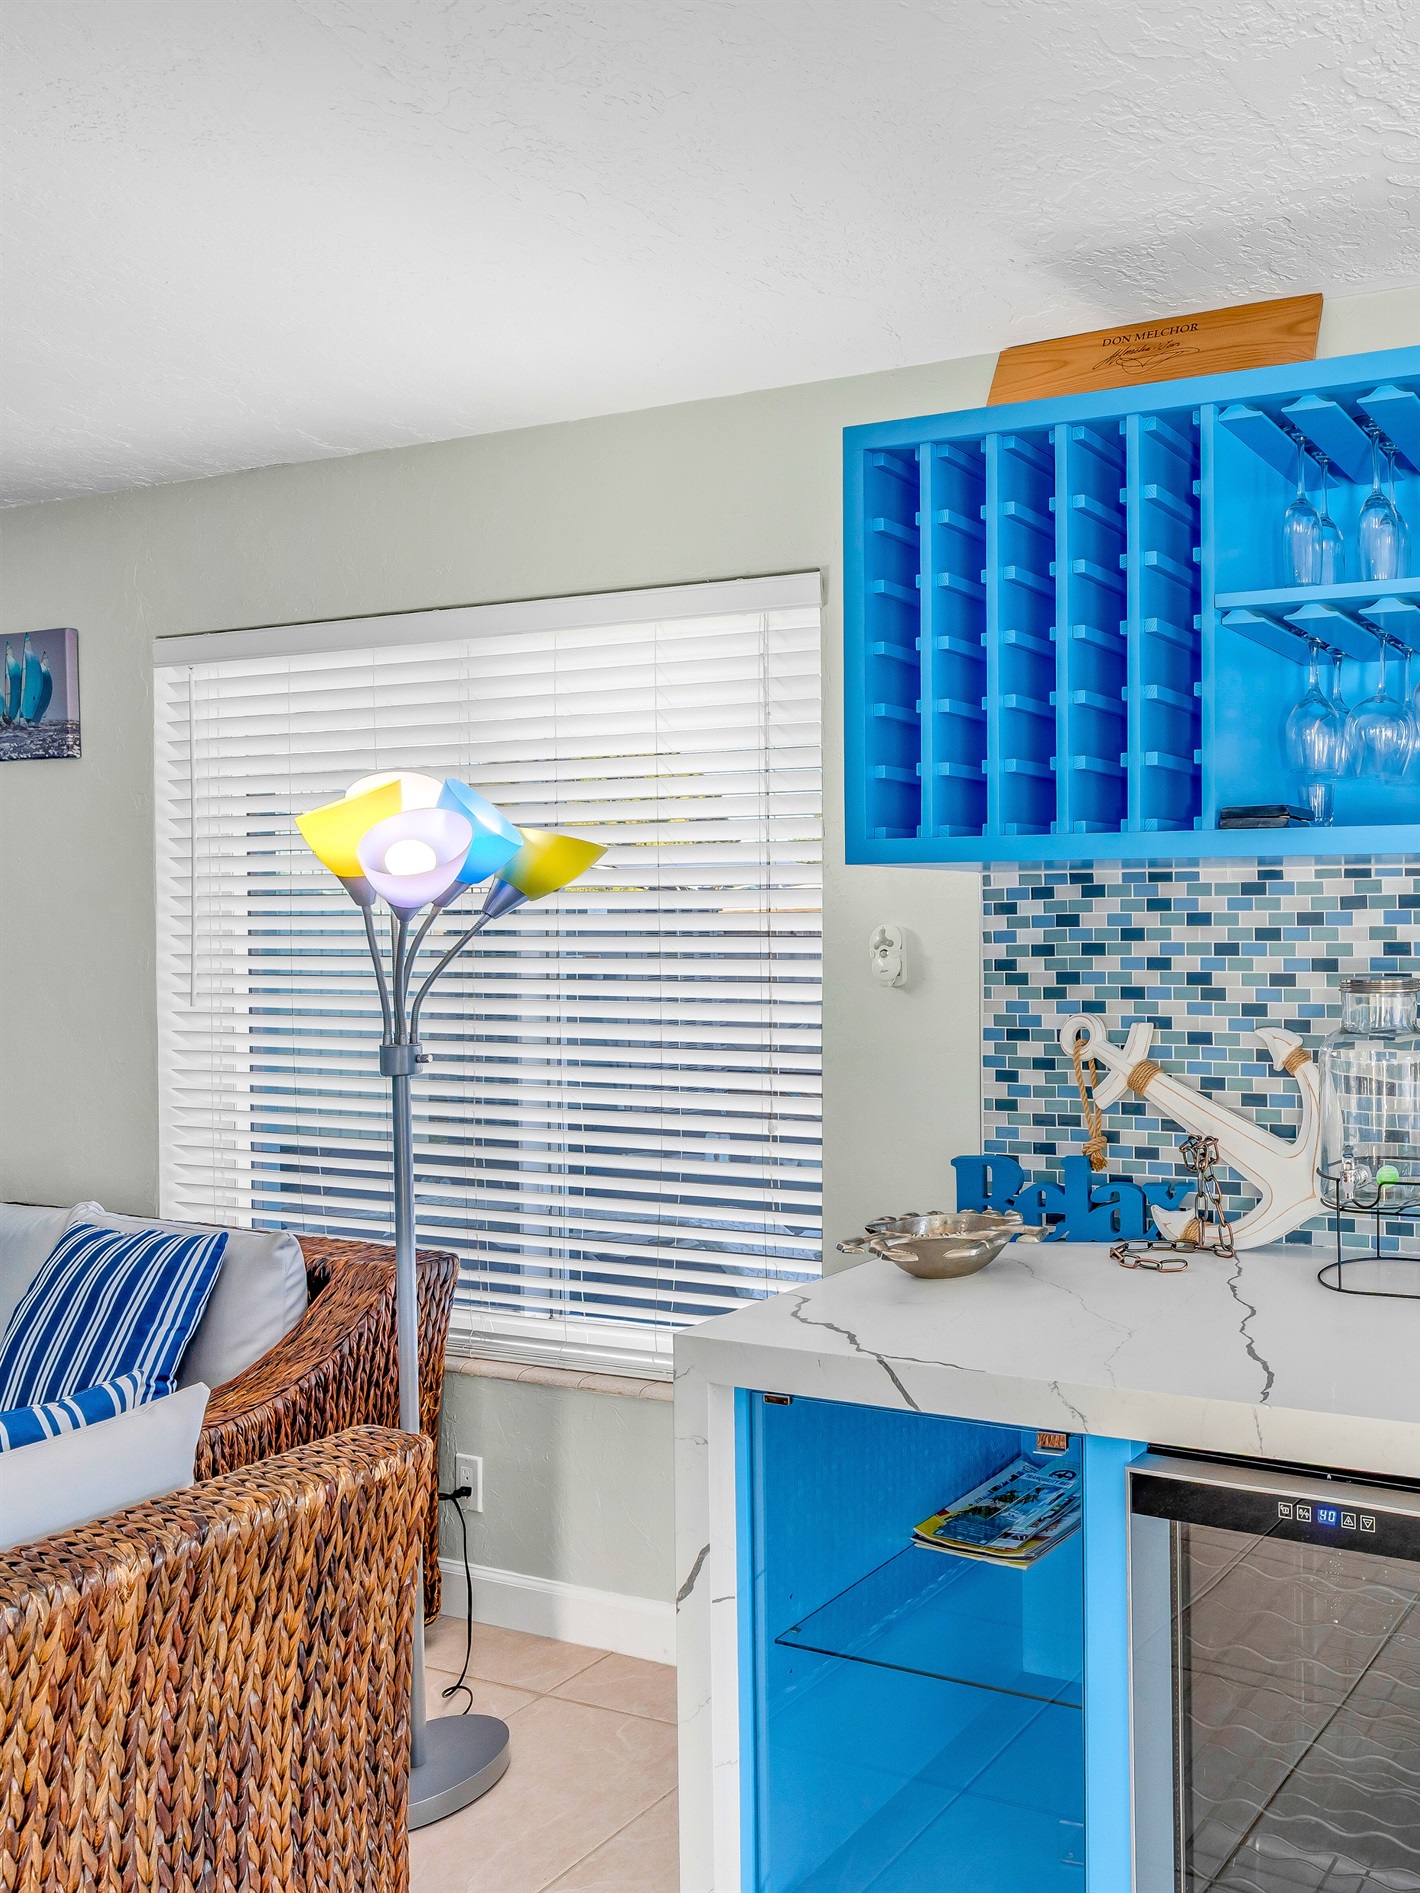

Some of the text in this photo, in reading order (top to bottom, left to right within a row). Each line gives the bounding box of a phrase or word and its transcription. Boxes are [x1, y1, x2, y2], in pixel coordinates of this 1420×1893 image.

[1101, 322, 1199, 347] DON MELCHOR
[951, 1155, 1195, 1242] Relax
[1319, 1509, 1336, 1522] 40
